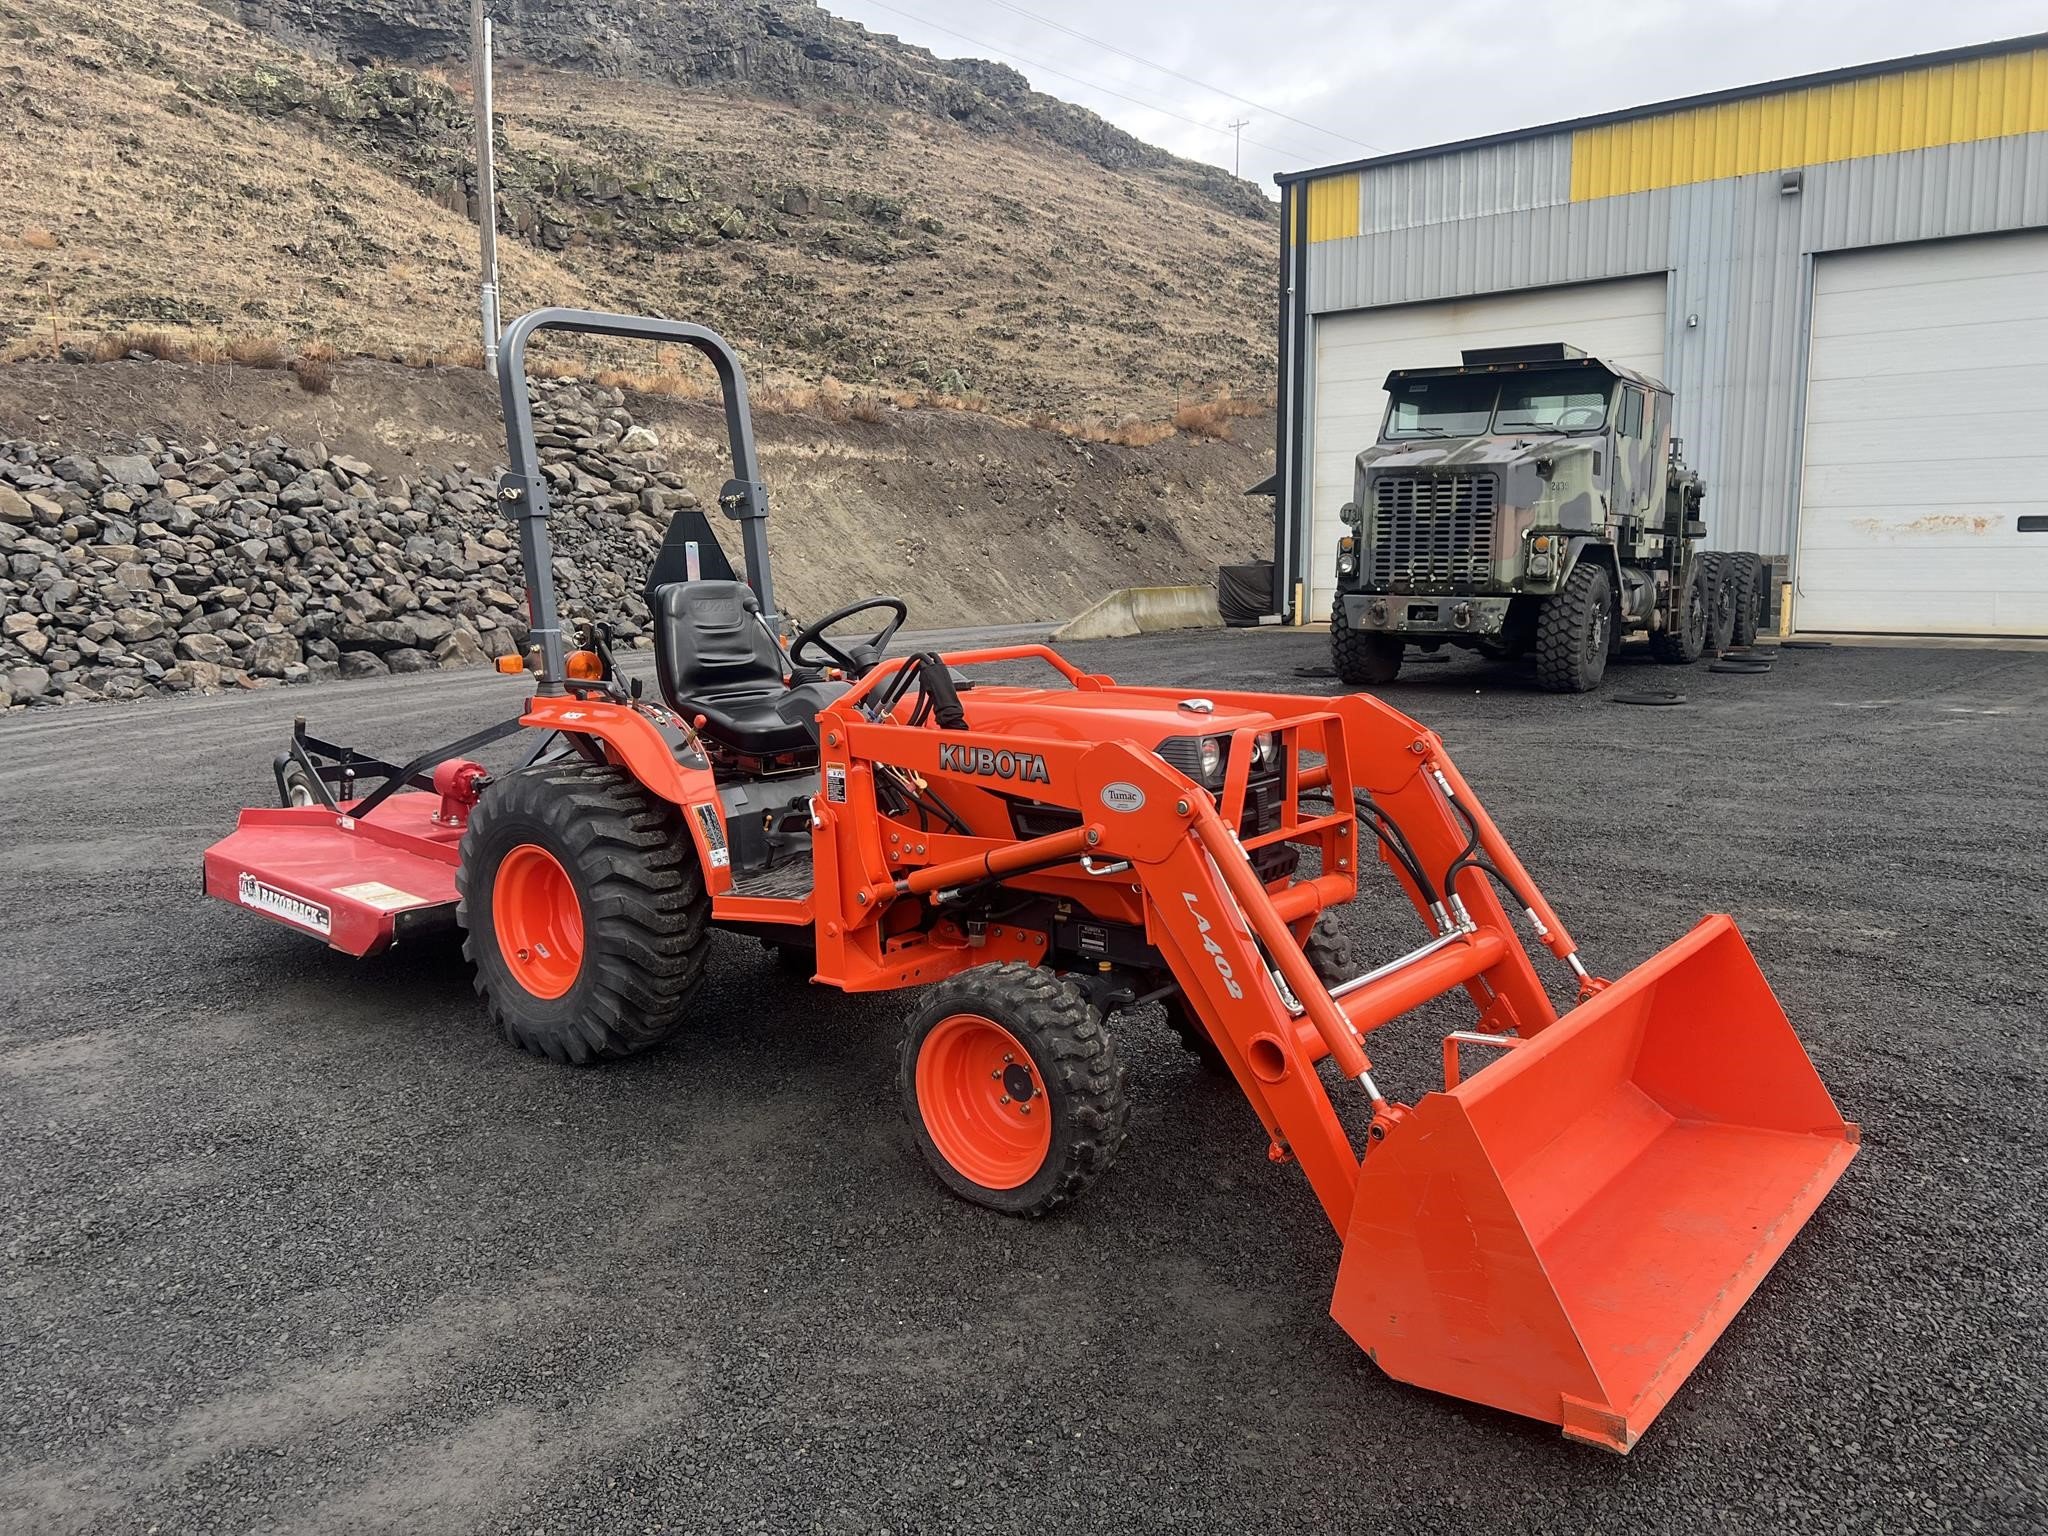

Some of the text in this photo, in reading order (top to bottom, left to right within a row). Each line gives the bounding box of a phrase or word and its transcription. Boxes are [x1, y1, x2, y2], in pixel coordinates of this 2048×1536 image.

[939, 742, 1050, 784] KUBOTA
[1108, 790, 1137, 801] Tumac
[260, 886, 319, 923] RAZORBACK
[1181, 891, 1243, 1000] LA402
